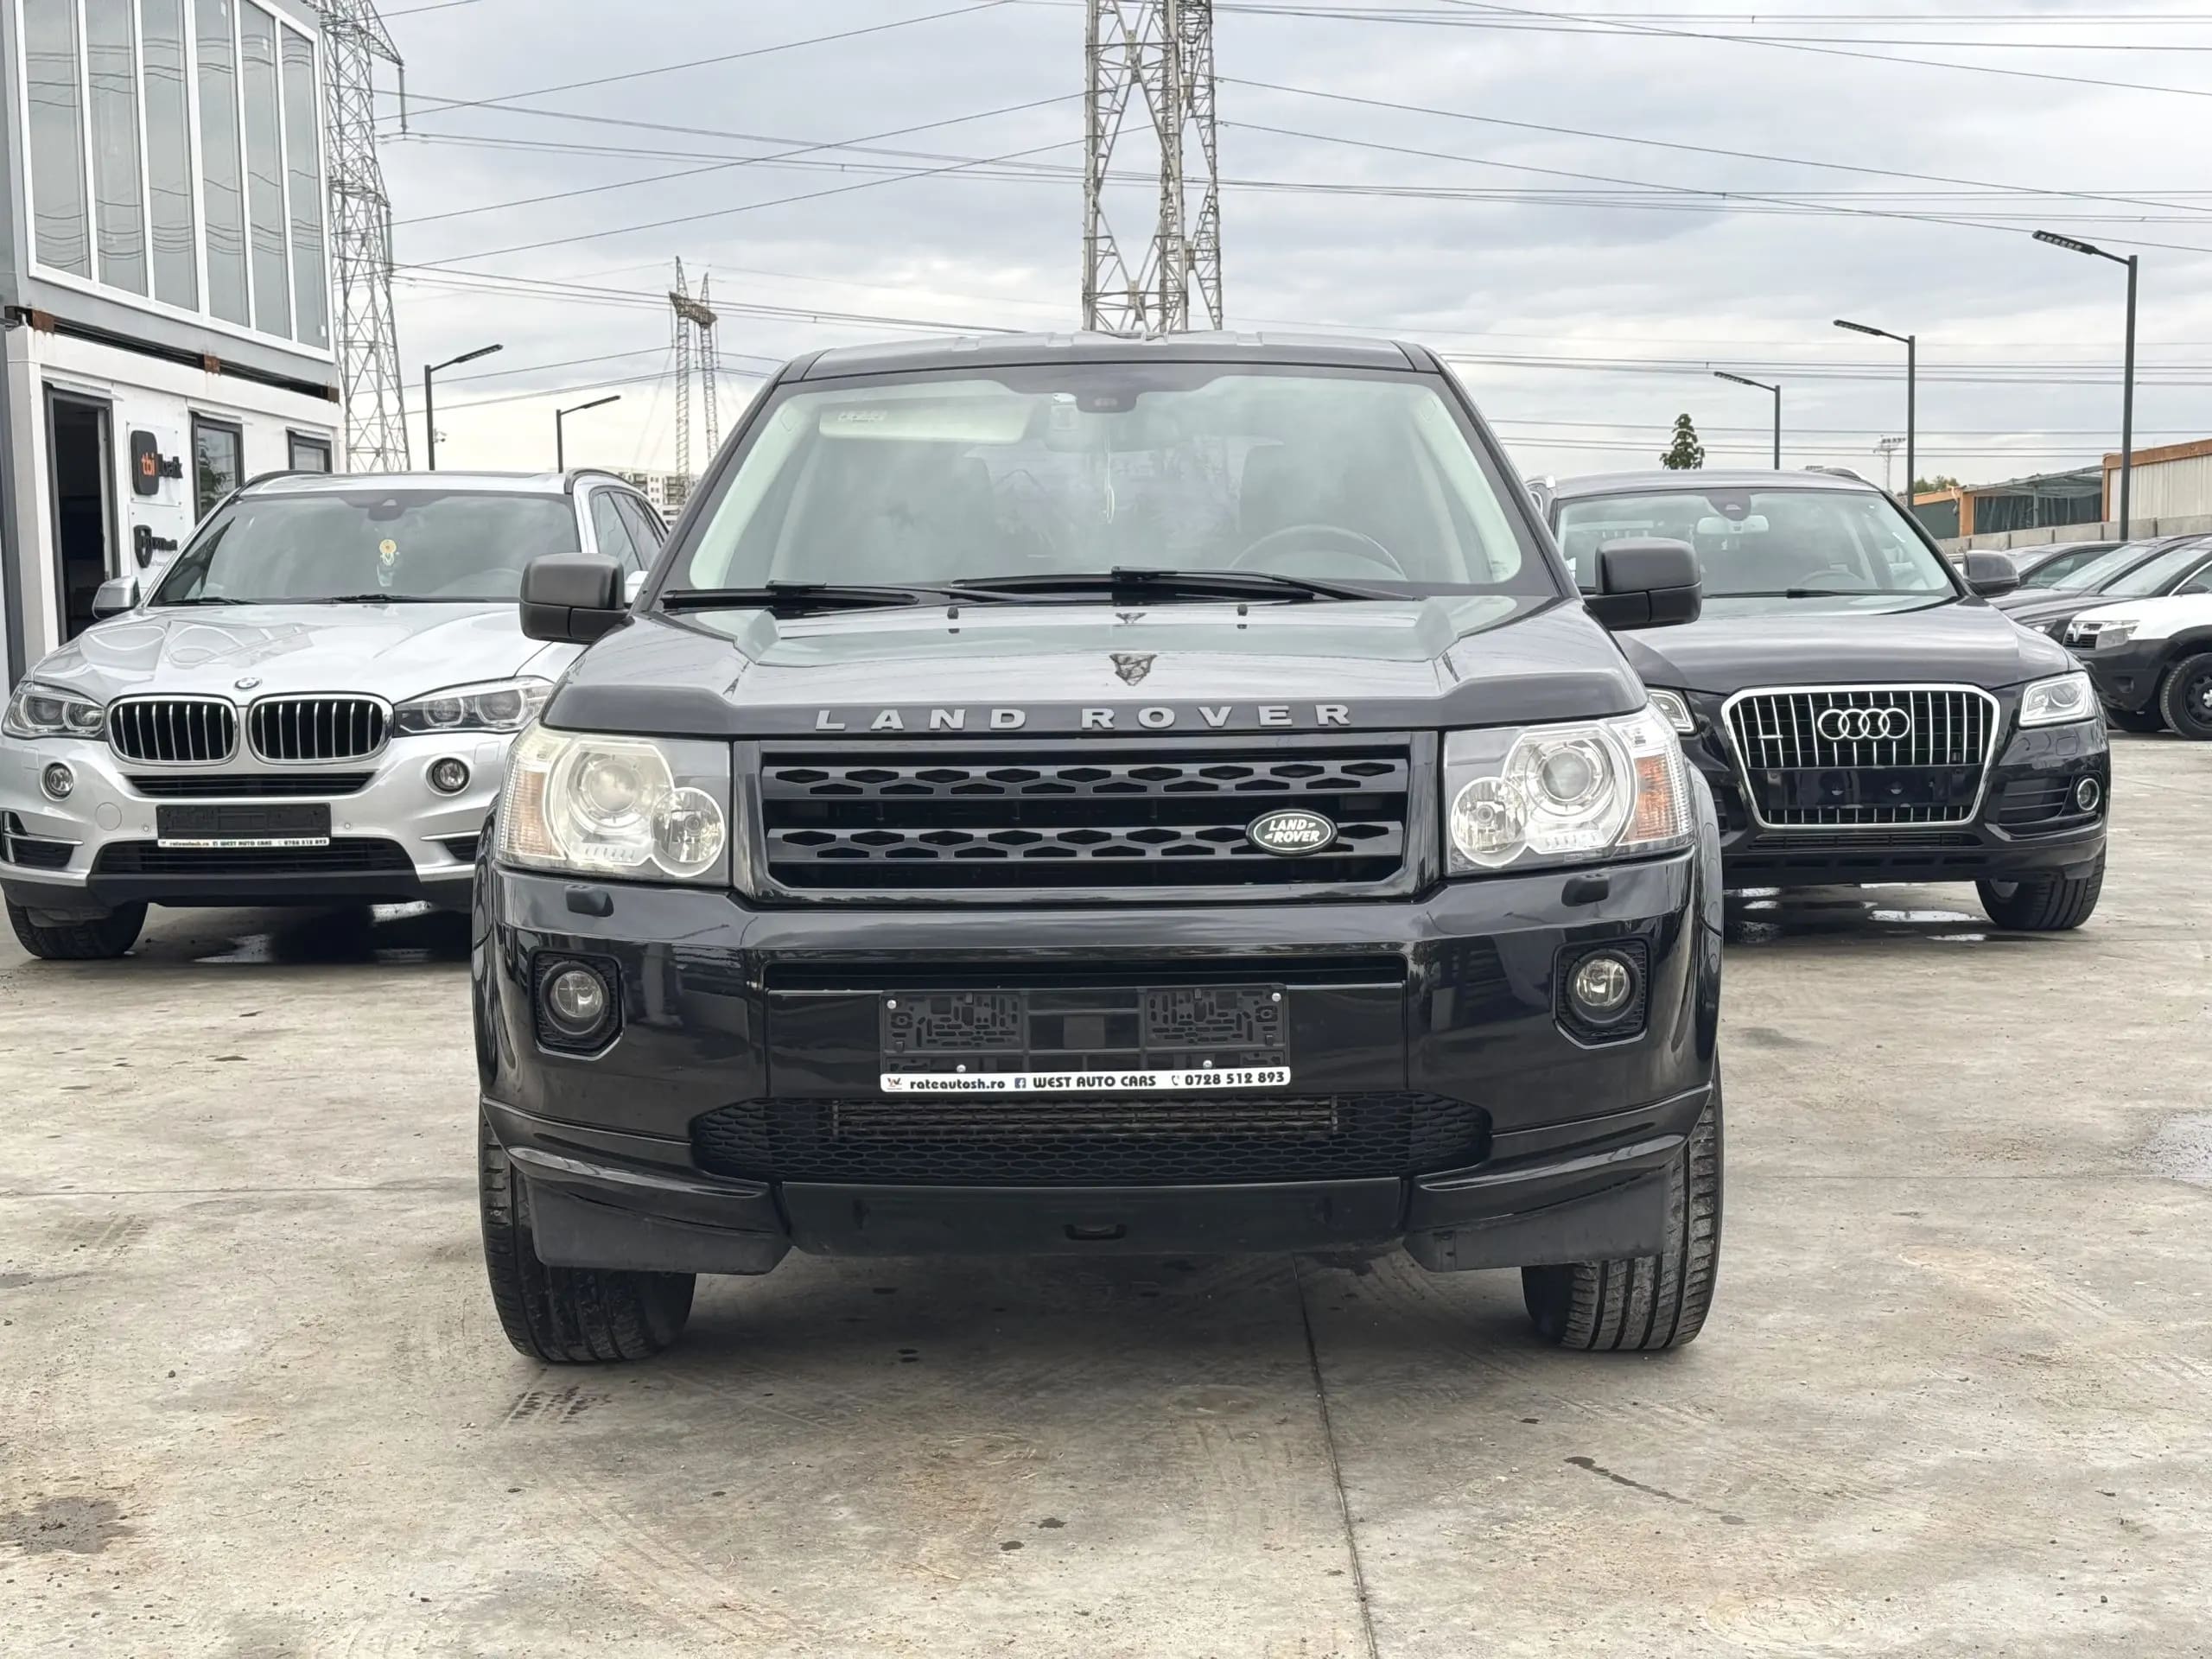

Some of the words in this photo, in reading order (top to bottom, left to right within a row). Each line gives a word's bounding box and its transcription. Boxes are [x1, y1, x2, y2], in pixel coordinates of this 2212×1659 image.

[141, 452, 156, 476] tbi
[815, 709, 1027, 731] LAND
[1081, 703, 1351, 729] ROVER
[1268, 818, 1307, 831] LAND
[1273, 830, 1320, 843] ROVER
[910, 1078, 1006, 1090] rateautosh.ro
[1033, 1077, 1072, 1090] WEST
[1076, 1076, 1116, 1088] AUTO
[1120, 1075, 1157, 1087] CARS
[1185, 1073, 1222, 1086] 0728
[1226, 1072, 1254, 1085] 512
[1257, 1071, 1285, 1084] 893
